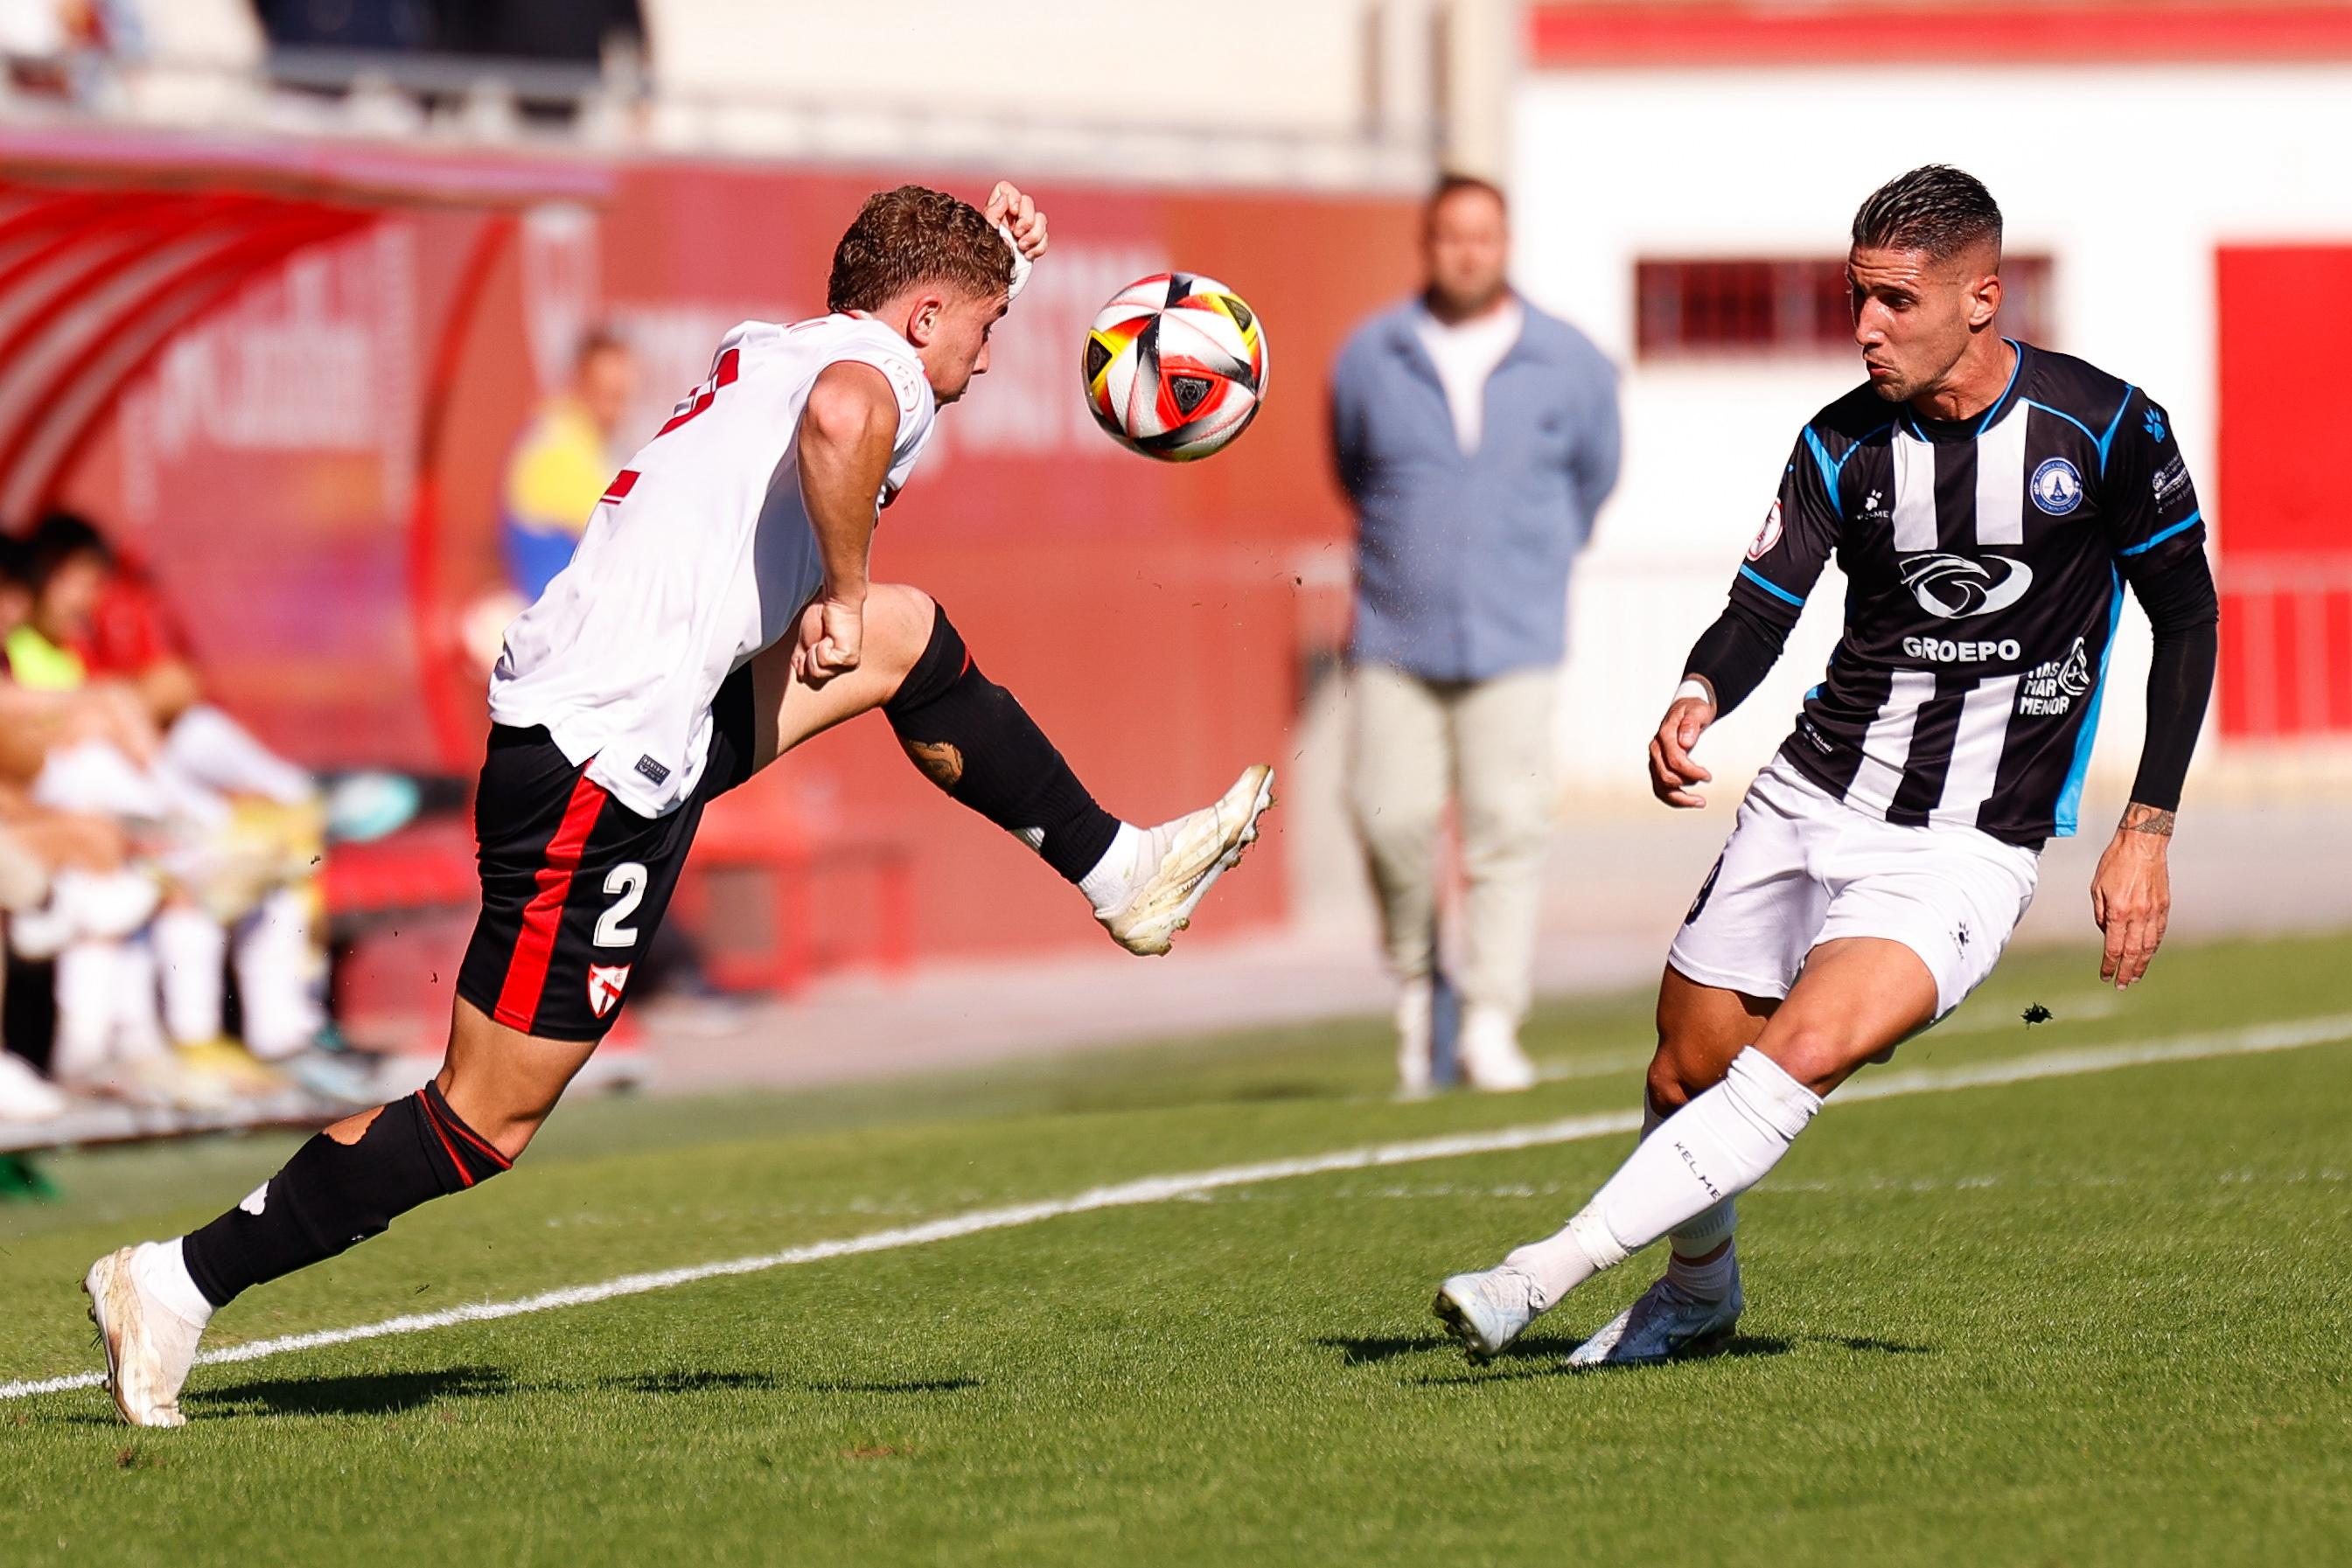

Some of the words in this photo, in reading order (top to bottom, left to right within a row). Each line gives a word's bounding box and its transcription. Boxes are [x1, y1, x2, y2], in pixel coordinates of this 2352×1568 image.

[1902, 637, 2020, 662] GROEPO
[2023, 679, 2056, 696] MAR
[2019, 696, 2070, 715] MENOR
[593, 861, 648, 947] 2
[1674, 1141, 1720, 1202] KELME
